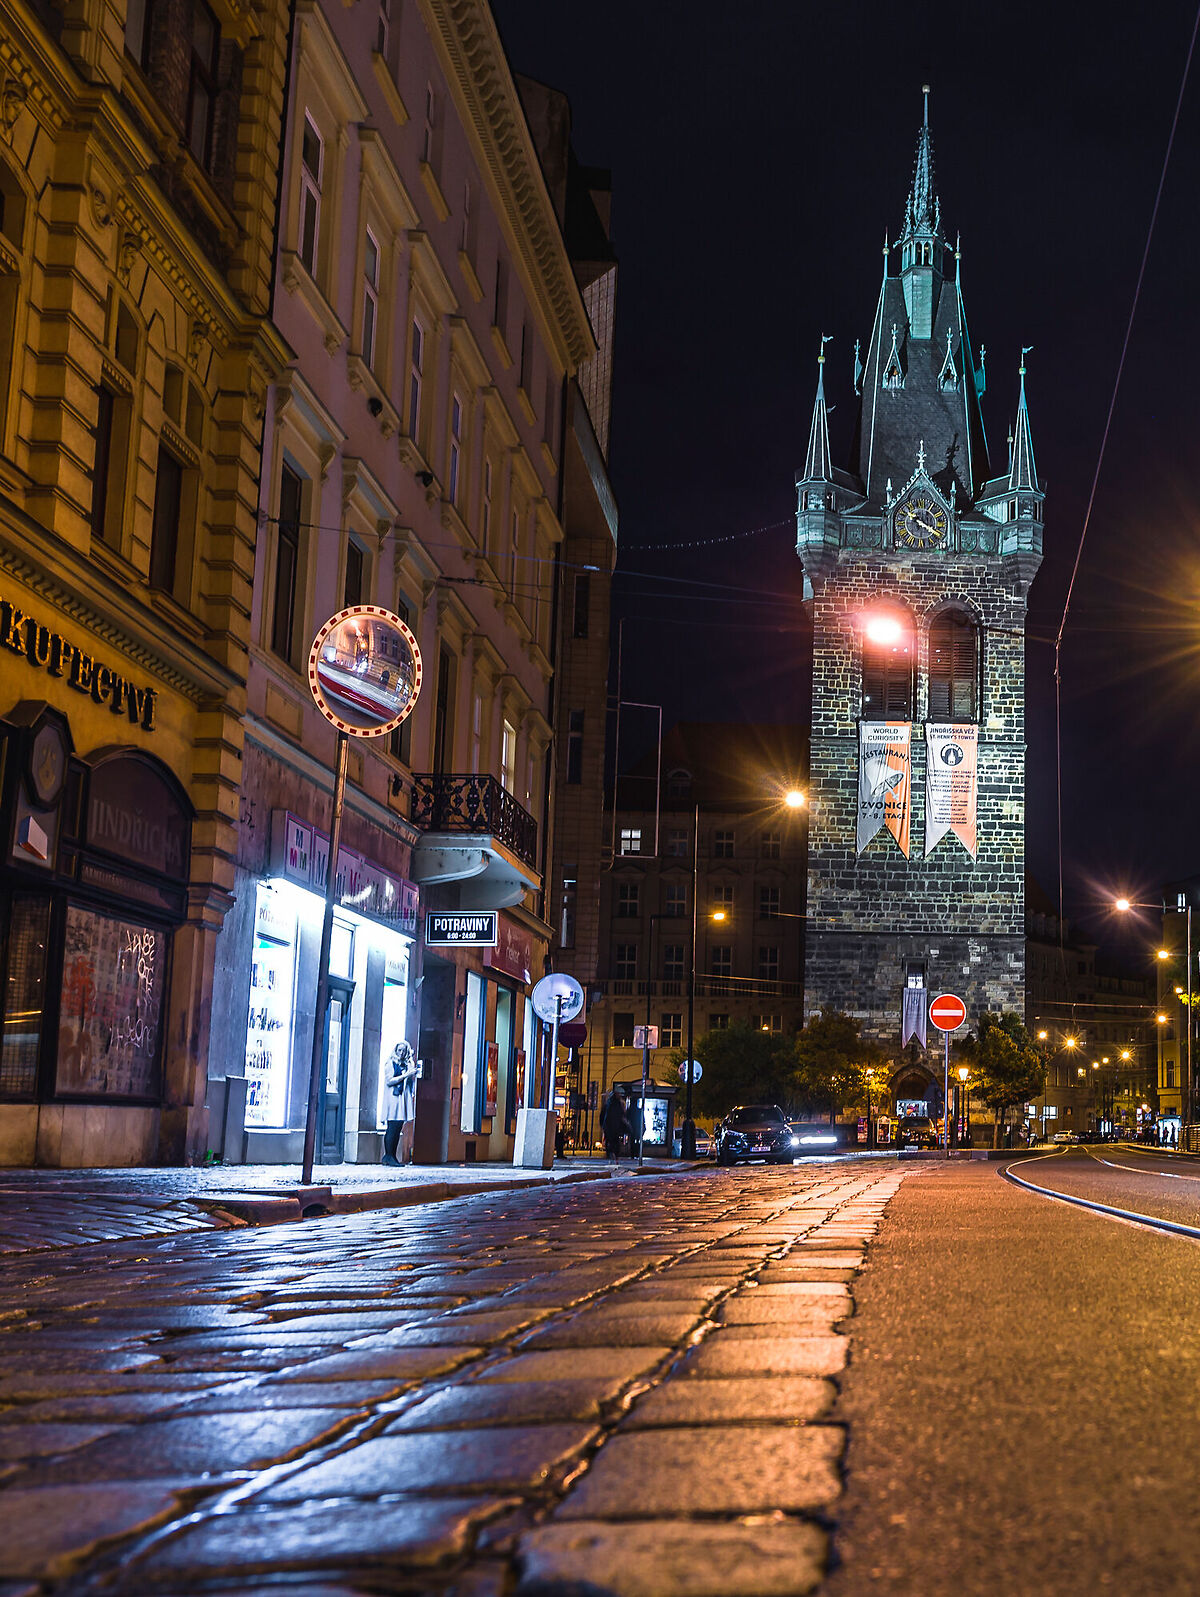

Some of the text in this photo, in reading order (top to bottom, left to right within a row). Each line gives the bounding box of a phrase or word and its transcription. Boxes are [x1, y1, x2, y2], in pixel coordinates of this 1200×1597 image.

[0, 599, 159, 732] KUPECTVÍ
[861, 801, 907, 809] ZVONICE
[434, 918, 490, 931] POTRAVINY
